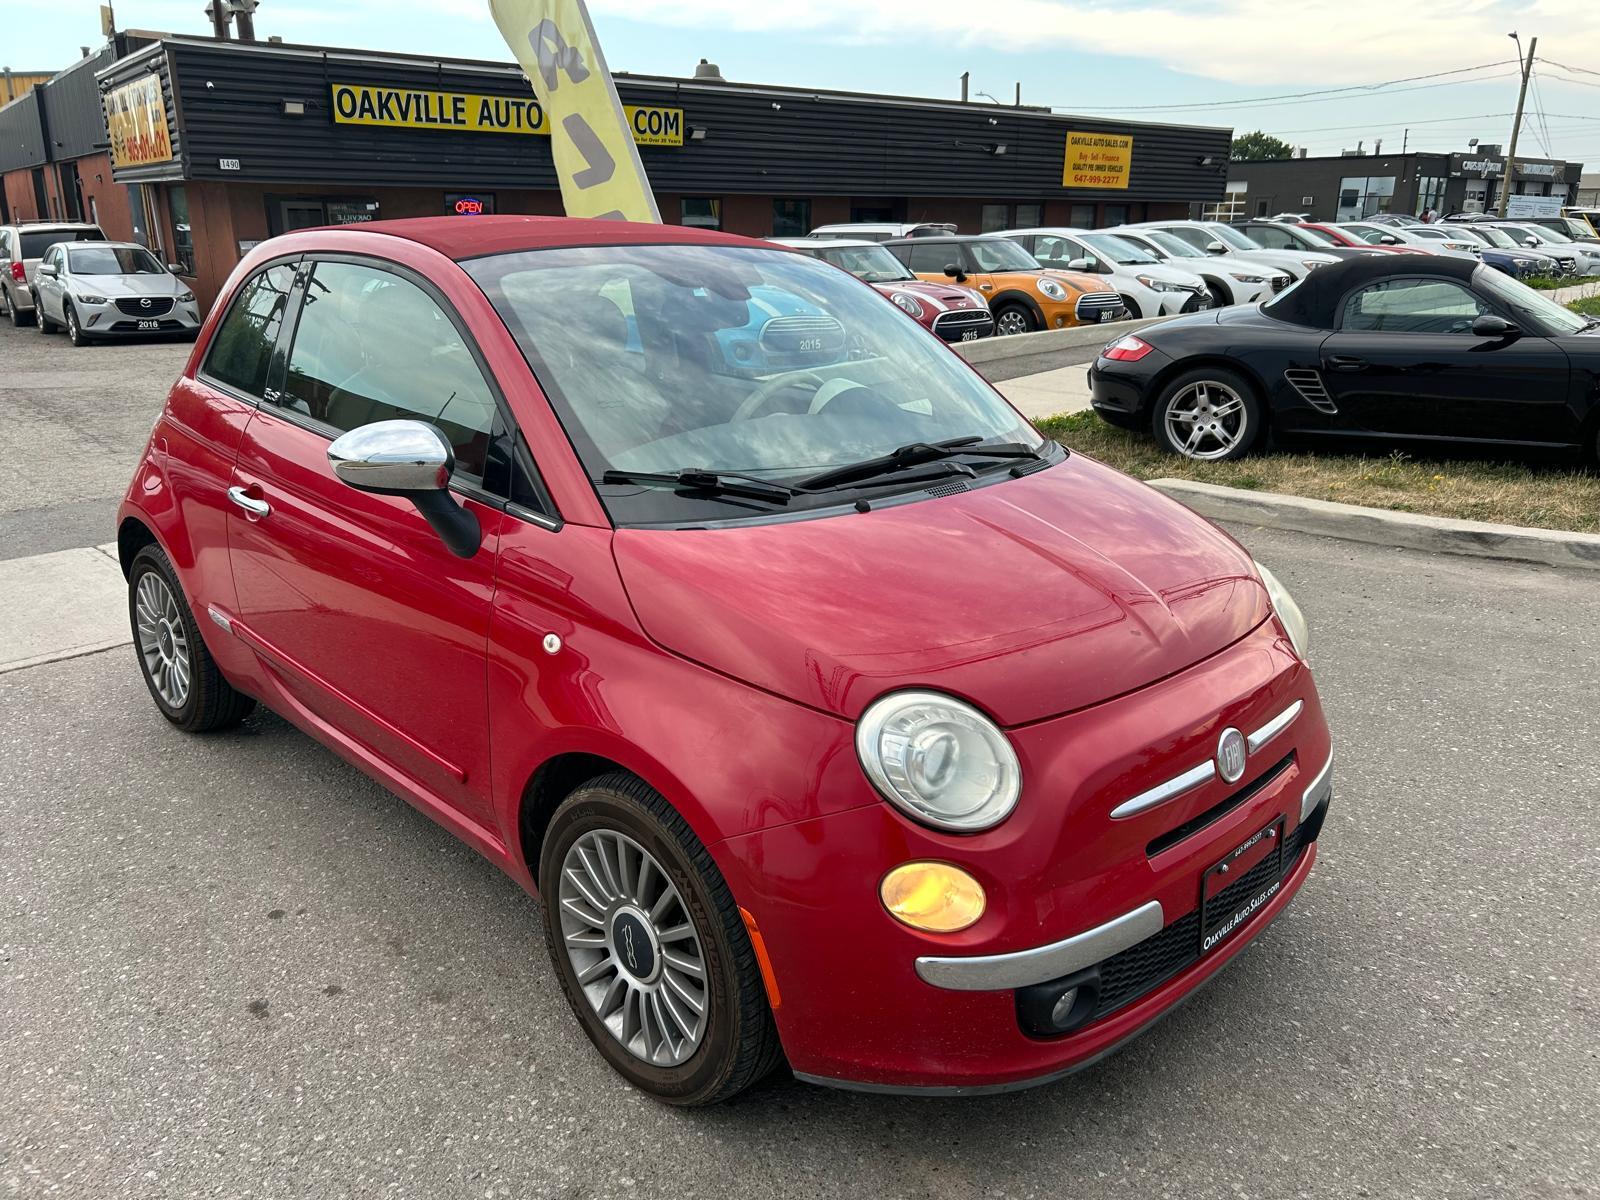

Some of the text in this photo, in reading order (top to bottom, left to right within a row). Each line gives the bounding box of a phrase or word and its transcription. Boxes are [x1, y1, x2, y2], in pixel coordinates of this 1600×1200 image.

[336, 87, 679, 136] OAKVILLE AUTO COM
[1071, 136, 1128, 148] OAKVILLE AUTO SALES.COM
[1079, 152, 1088, 162] Buy
[1102, 153, 1120, 162] Finance
[221, 160, 238, 169] 1490
[1073, 163, 1087, 171] QUALITY
[1095, 164, 1106, 172] OWNED
[1107, 165, 1123, 173] VEHICLES
[1074, 175, 1119, 184] 647-999-2277
[455, 201, 483, 214] OPEN
[1101, 311, 1113, 320] 2017
[962, 331, 978, 341] 2015
[800, 339, 821, 350] 2015
[1225, 740, 1240, 771] FIAT
[1203, 919, 1234, 950] OAKVILLE
[1233, 906, 1250, 926] AUTO
